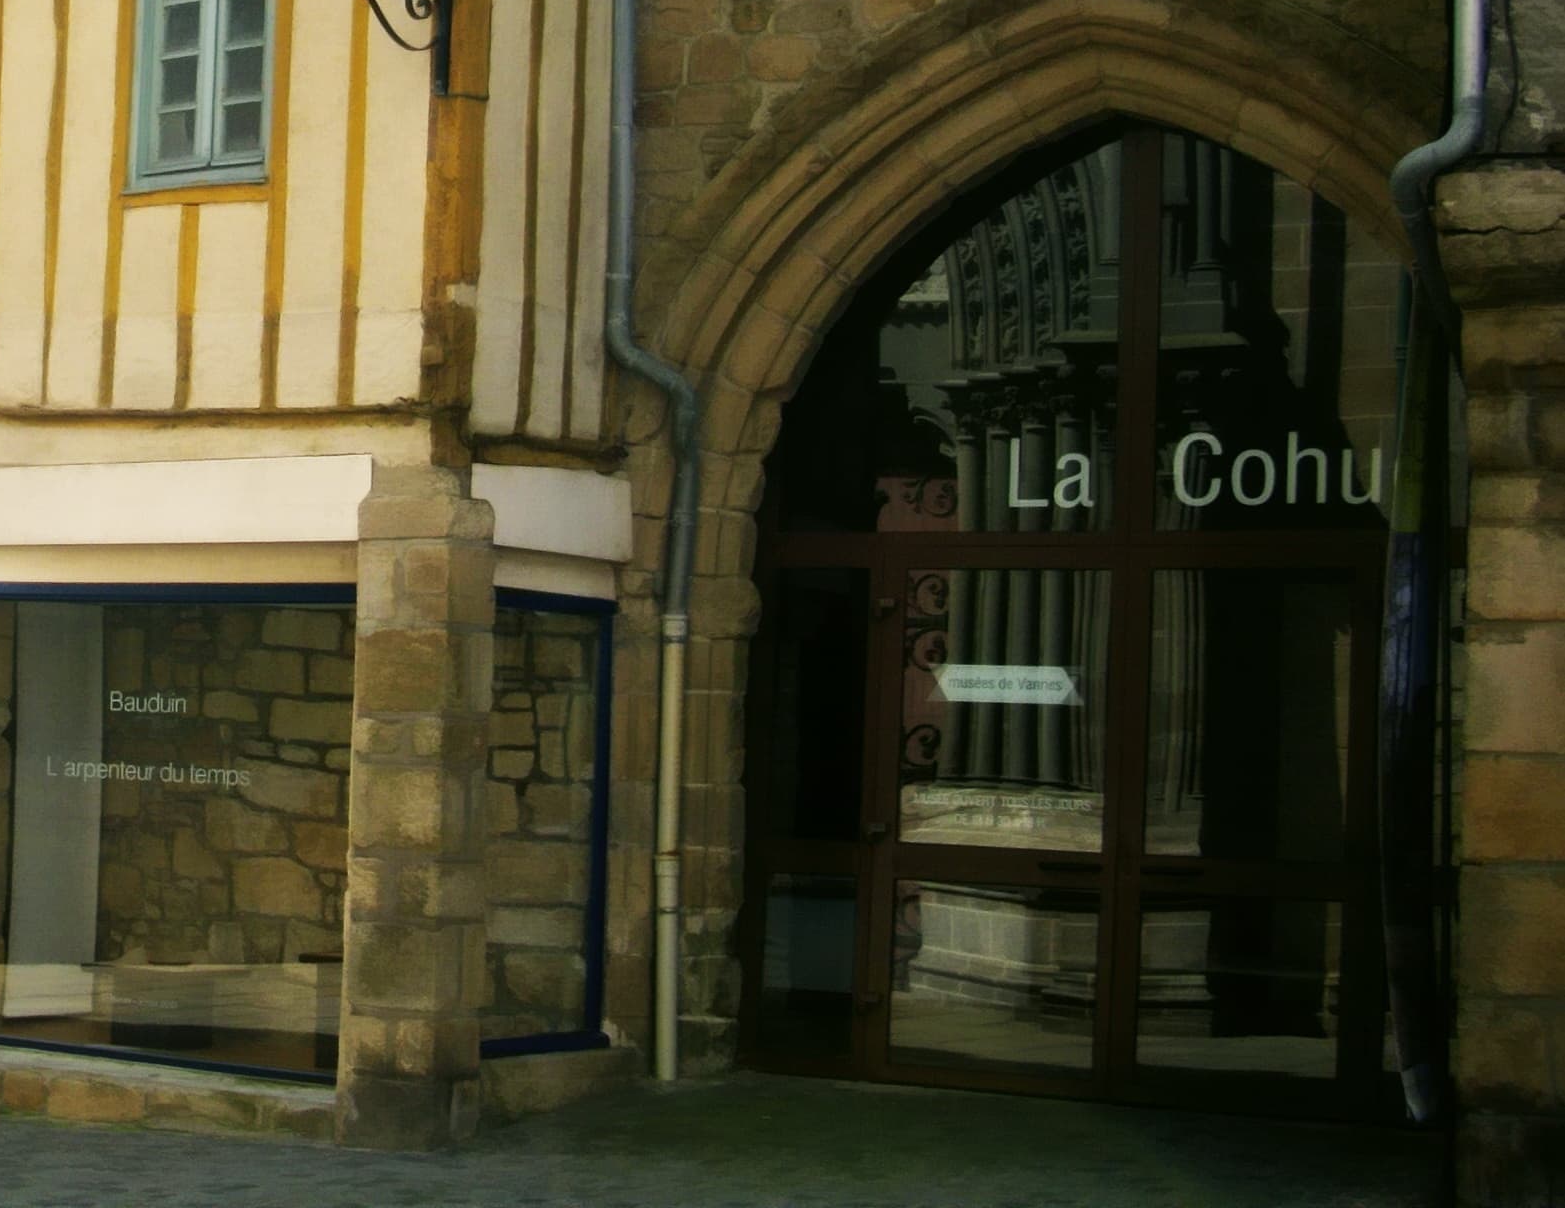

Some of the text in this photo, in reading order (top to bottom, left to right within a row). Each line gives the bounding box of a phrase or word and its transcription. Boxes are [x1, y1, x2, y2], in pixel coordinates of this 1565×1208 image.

[1008, 431, 1382, 508] La Cohu
[948, 677, 1063, 691] musées de Vannes
[109, 690, 187, 713] Bauduin
[159, 762, 184, 783] du
[190, 764, 251, 790] temps
